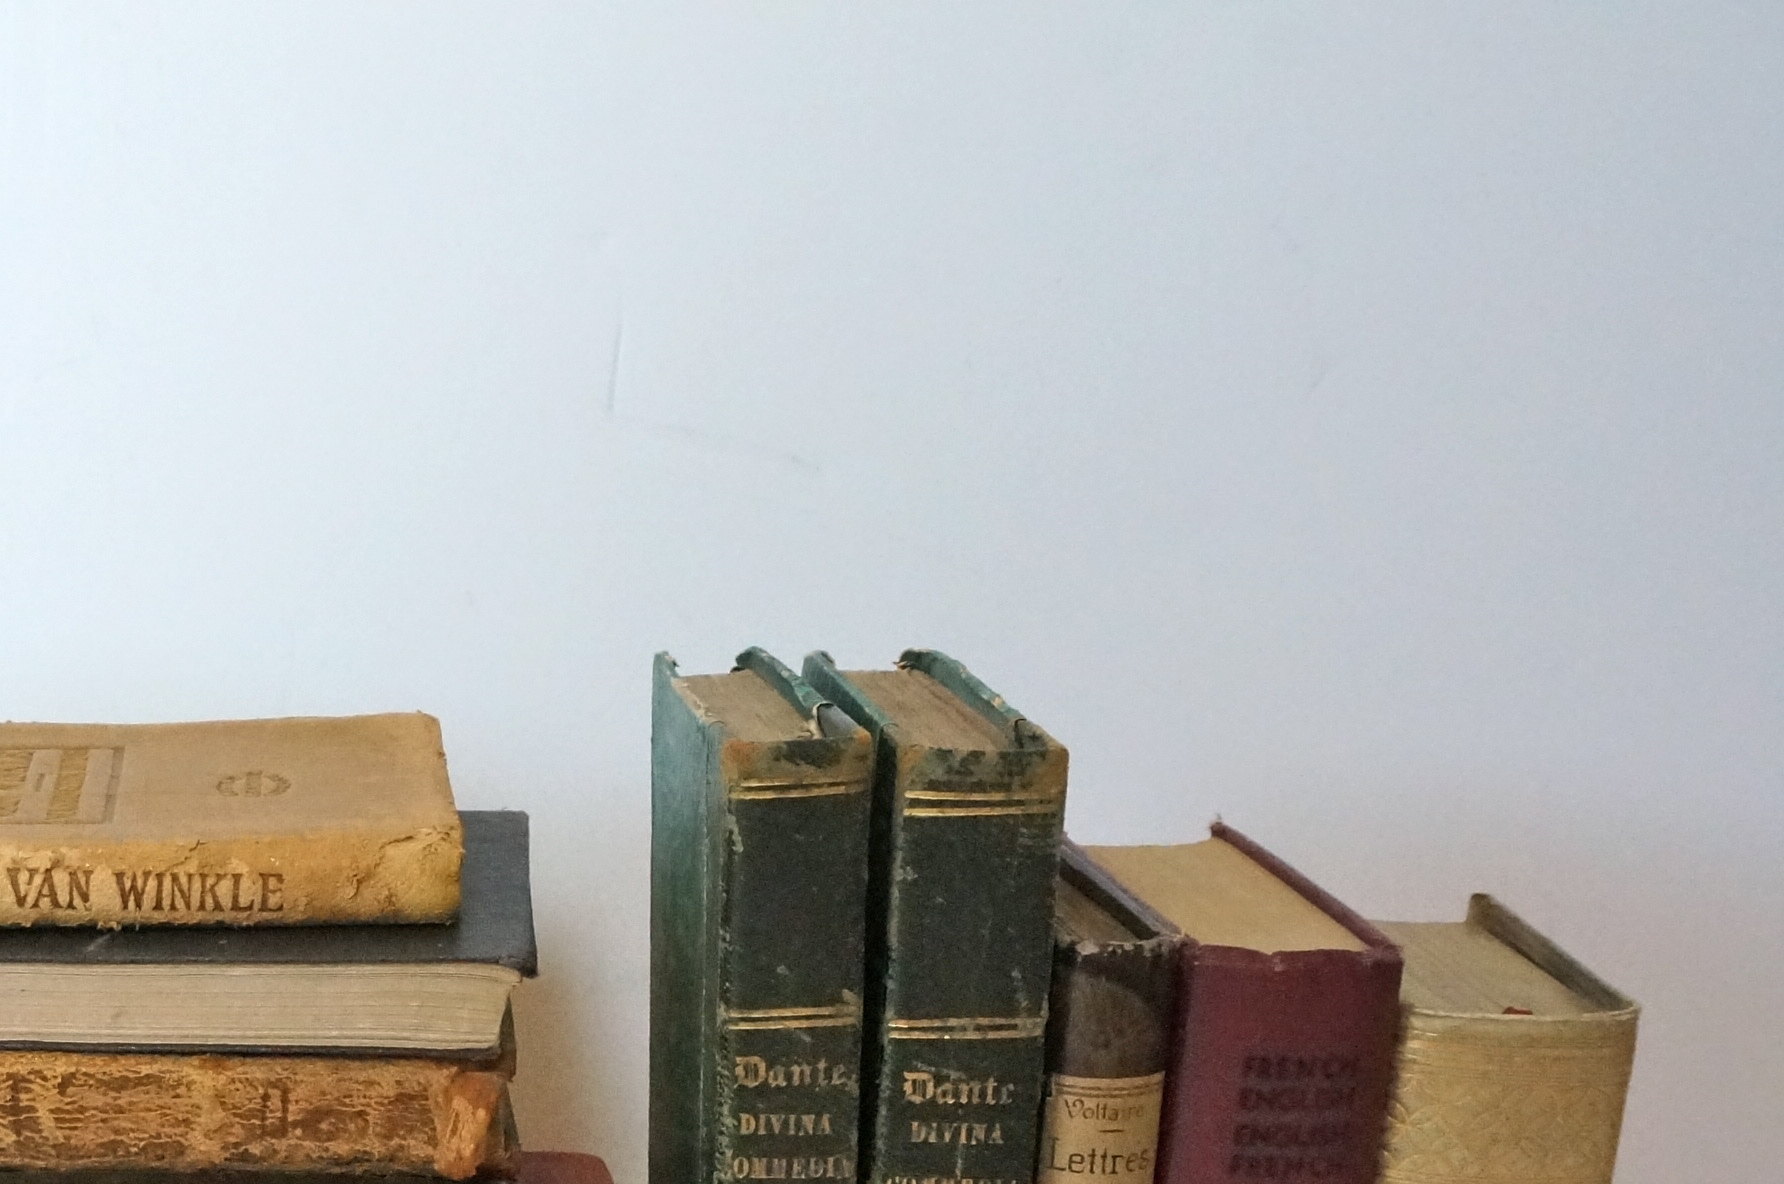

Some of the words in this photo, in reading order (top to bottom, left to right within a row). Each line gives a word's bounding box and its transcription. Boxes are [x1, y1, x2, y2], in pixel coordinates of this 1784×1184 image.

[6, 866, 94, 911] VAN
[113, 870, 286, 913] WINKLE
[734, 1055, 848, 1089] Dante
[903, 1071, 1016, 1105] Dante
[739, 1113, 832, 1136] DIVINA
[1064, 1098, 1145, 1122] Voltaire
[910, 1121, 1005, 1145] DIVINA
[725, 1155, 855, 1180] OMMEDIA
[1046, 1137, 1151, 1176] Lettres
